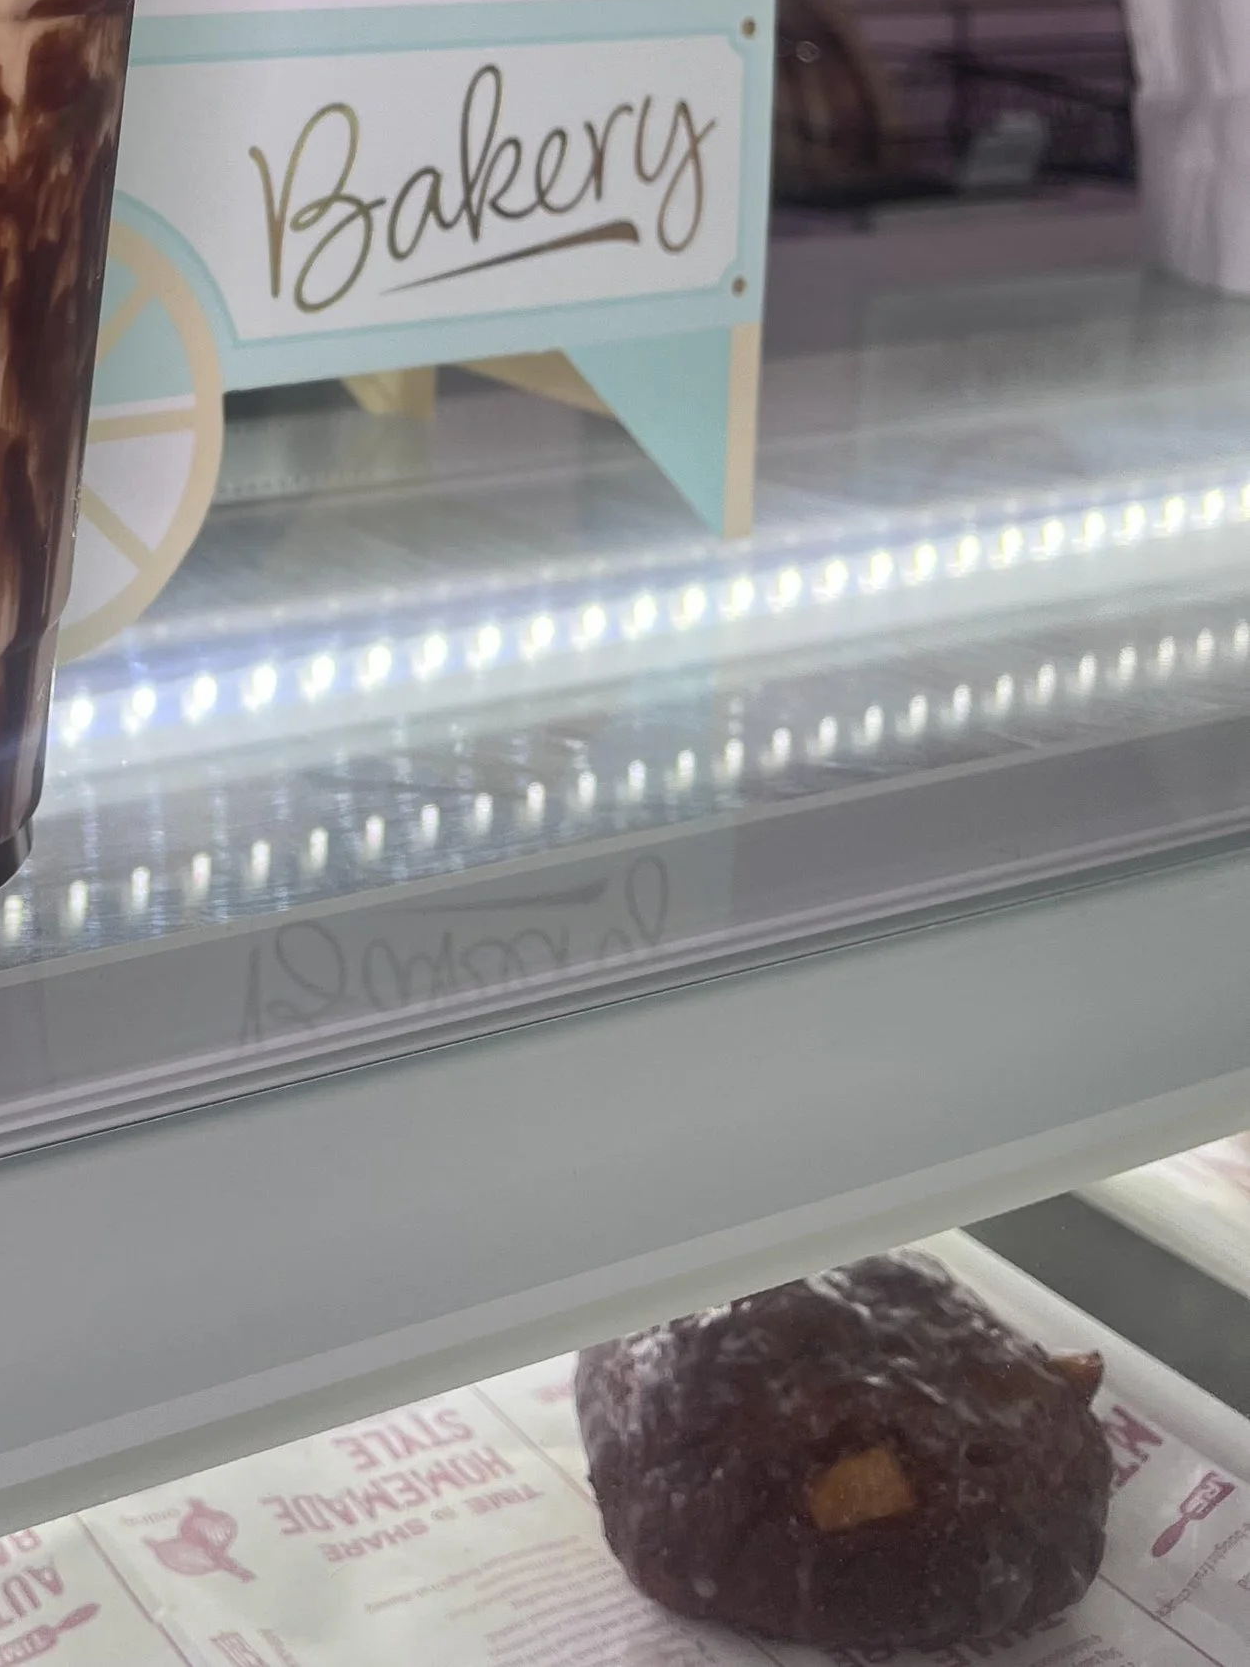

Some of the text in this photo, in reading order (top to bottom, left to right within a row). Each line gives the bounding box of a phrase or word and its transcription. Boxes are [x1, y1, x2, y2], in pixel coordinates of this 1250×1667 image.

[249, 63, 716, 313] Bakery
[331, 1409, 475, 1472] STYLE
[258, 1444, 516, 1536] HOMEMADE
[319, 1518, 430, 1562] SHARE
